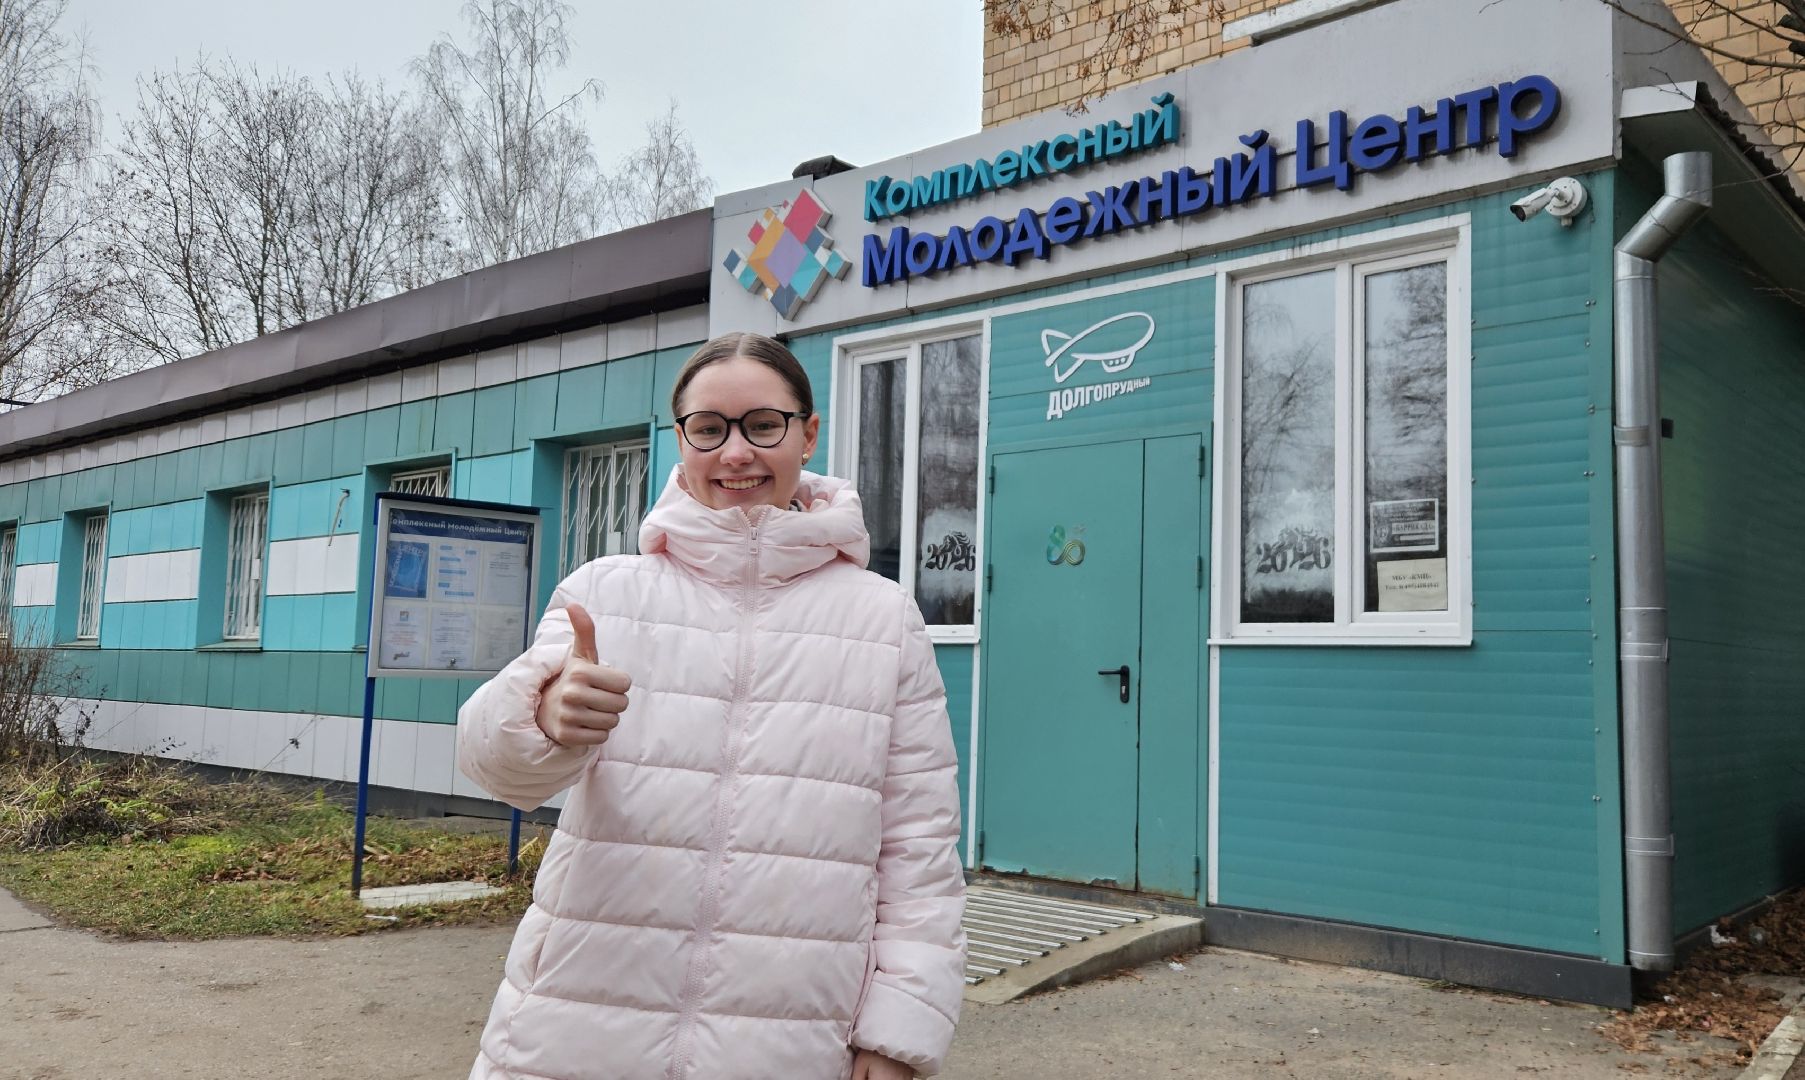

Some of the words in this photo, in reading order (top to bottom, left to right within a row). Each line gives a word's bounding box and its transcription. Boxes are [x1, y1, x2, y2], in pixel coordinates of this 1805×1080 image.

[862, 129, 1278, 288] Молодежный
[1296, 74, 1562, 190] Центр
[864, 91, 1181, 222] Комплексный
